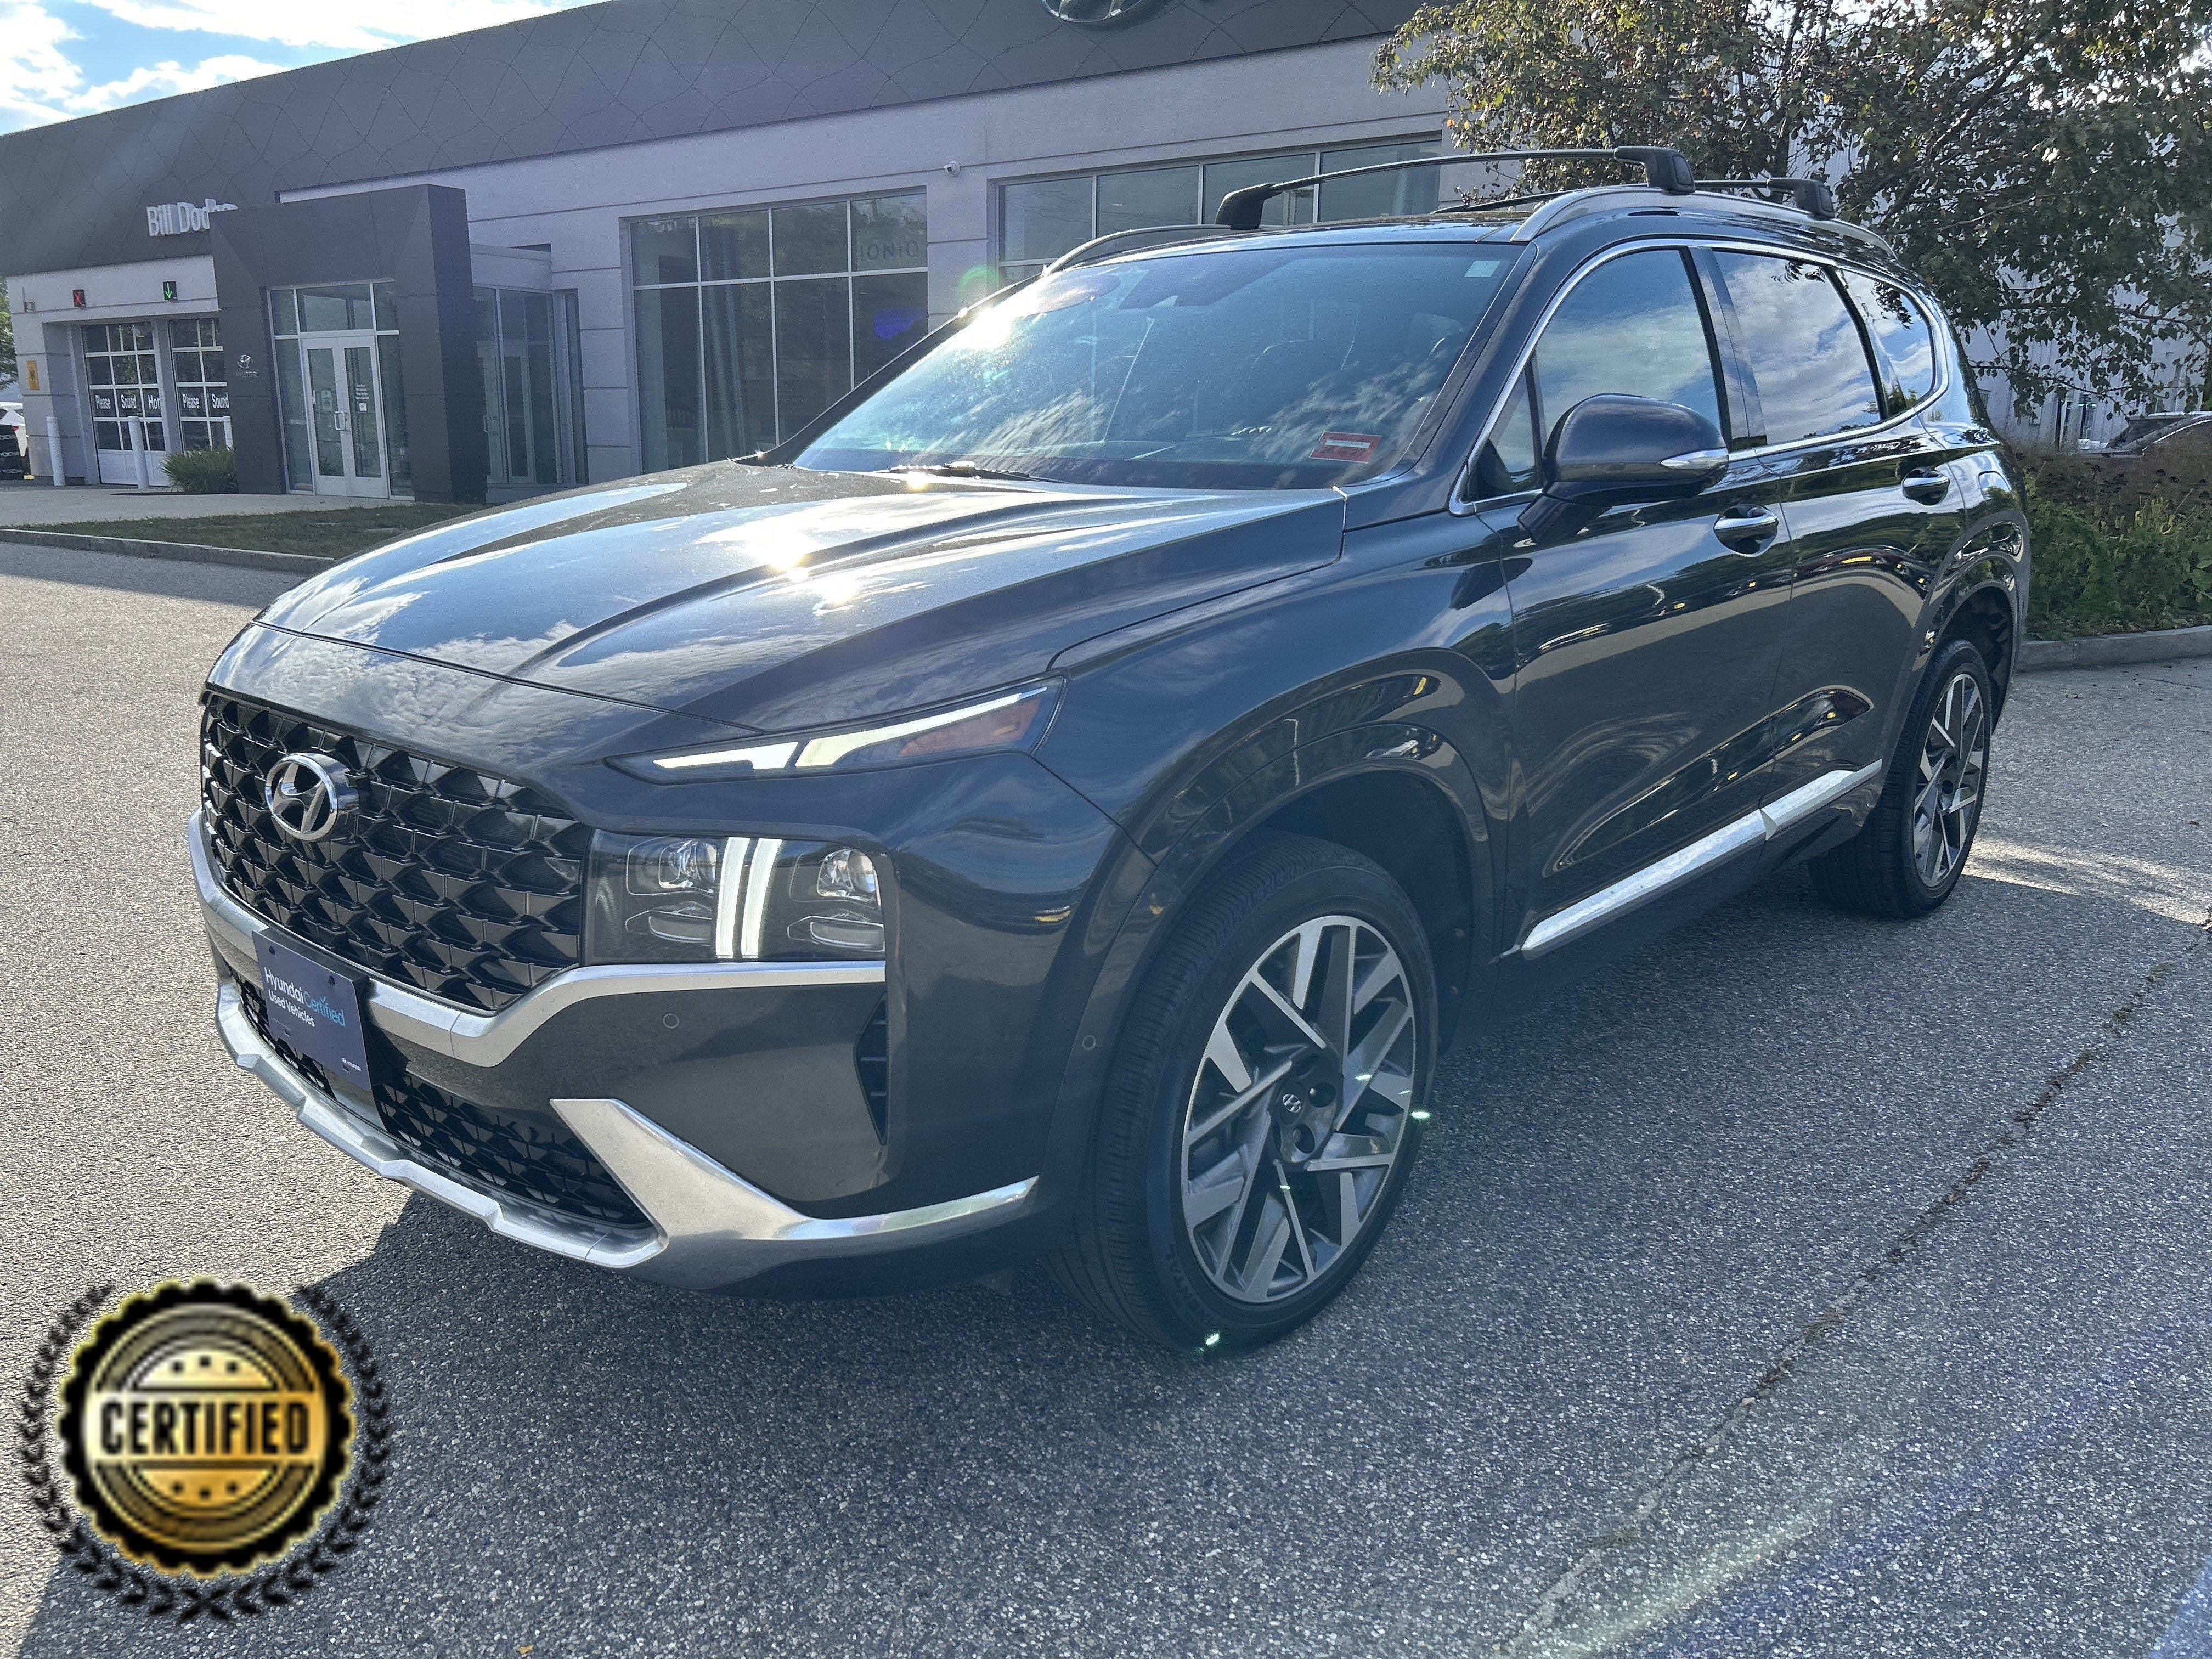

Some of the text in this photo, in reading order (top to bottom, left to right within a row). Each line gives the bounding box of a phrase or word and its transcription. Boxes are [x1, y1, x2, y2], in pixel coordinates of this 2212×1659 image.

[146, 198, 239, 236] Bill Dod
[95, 394, 160, 409] Please Sound Hor
[182, 392, 229, 409] Please Sound
[268, 989, 286, 1009] Used
[285, 998, 315, 1028] Vehicles
